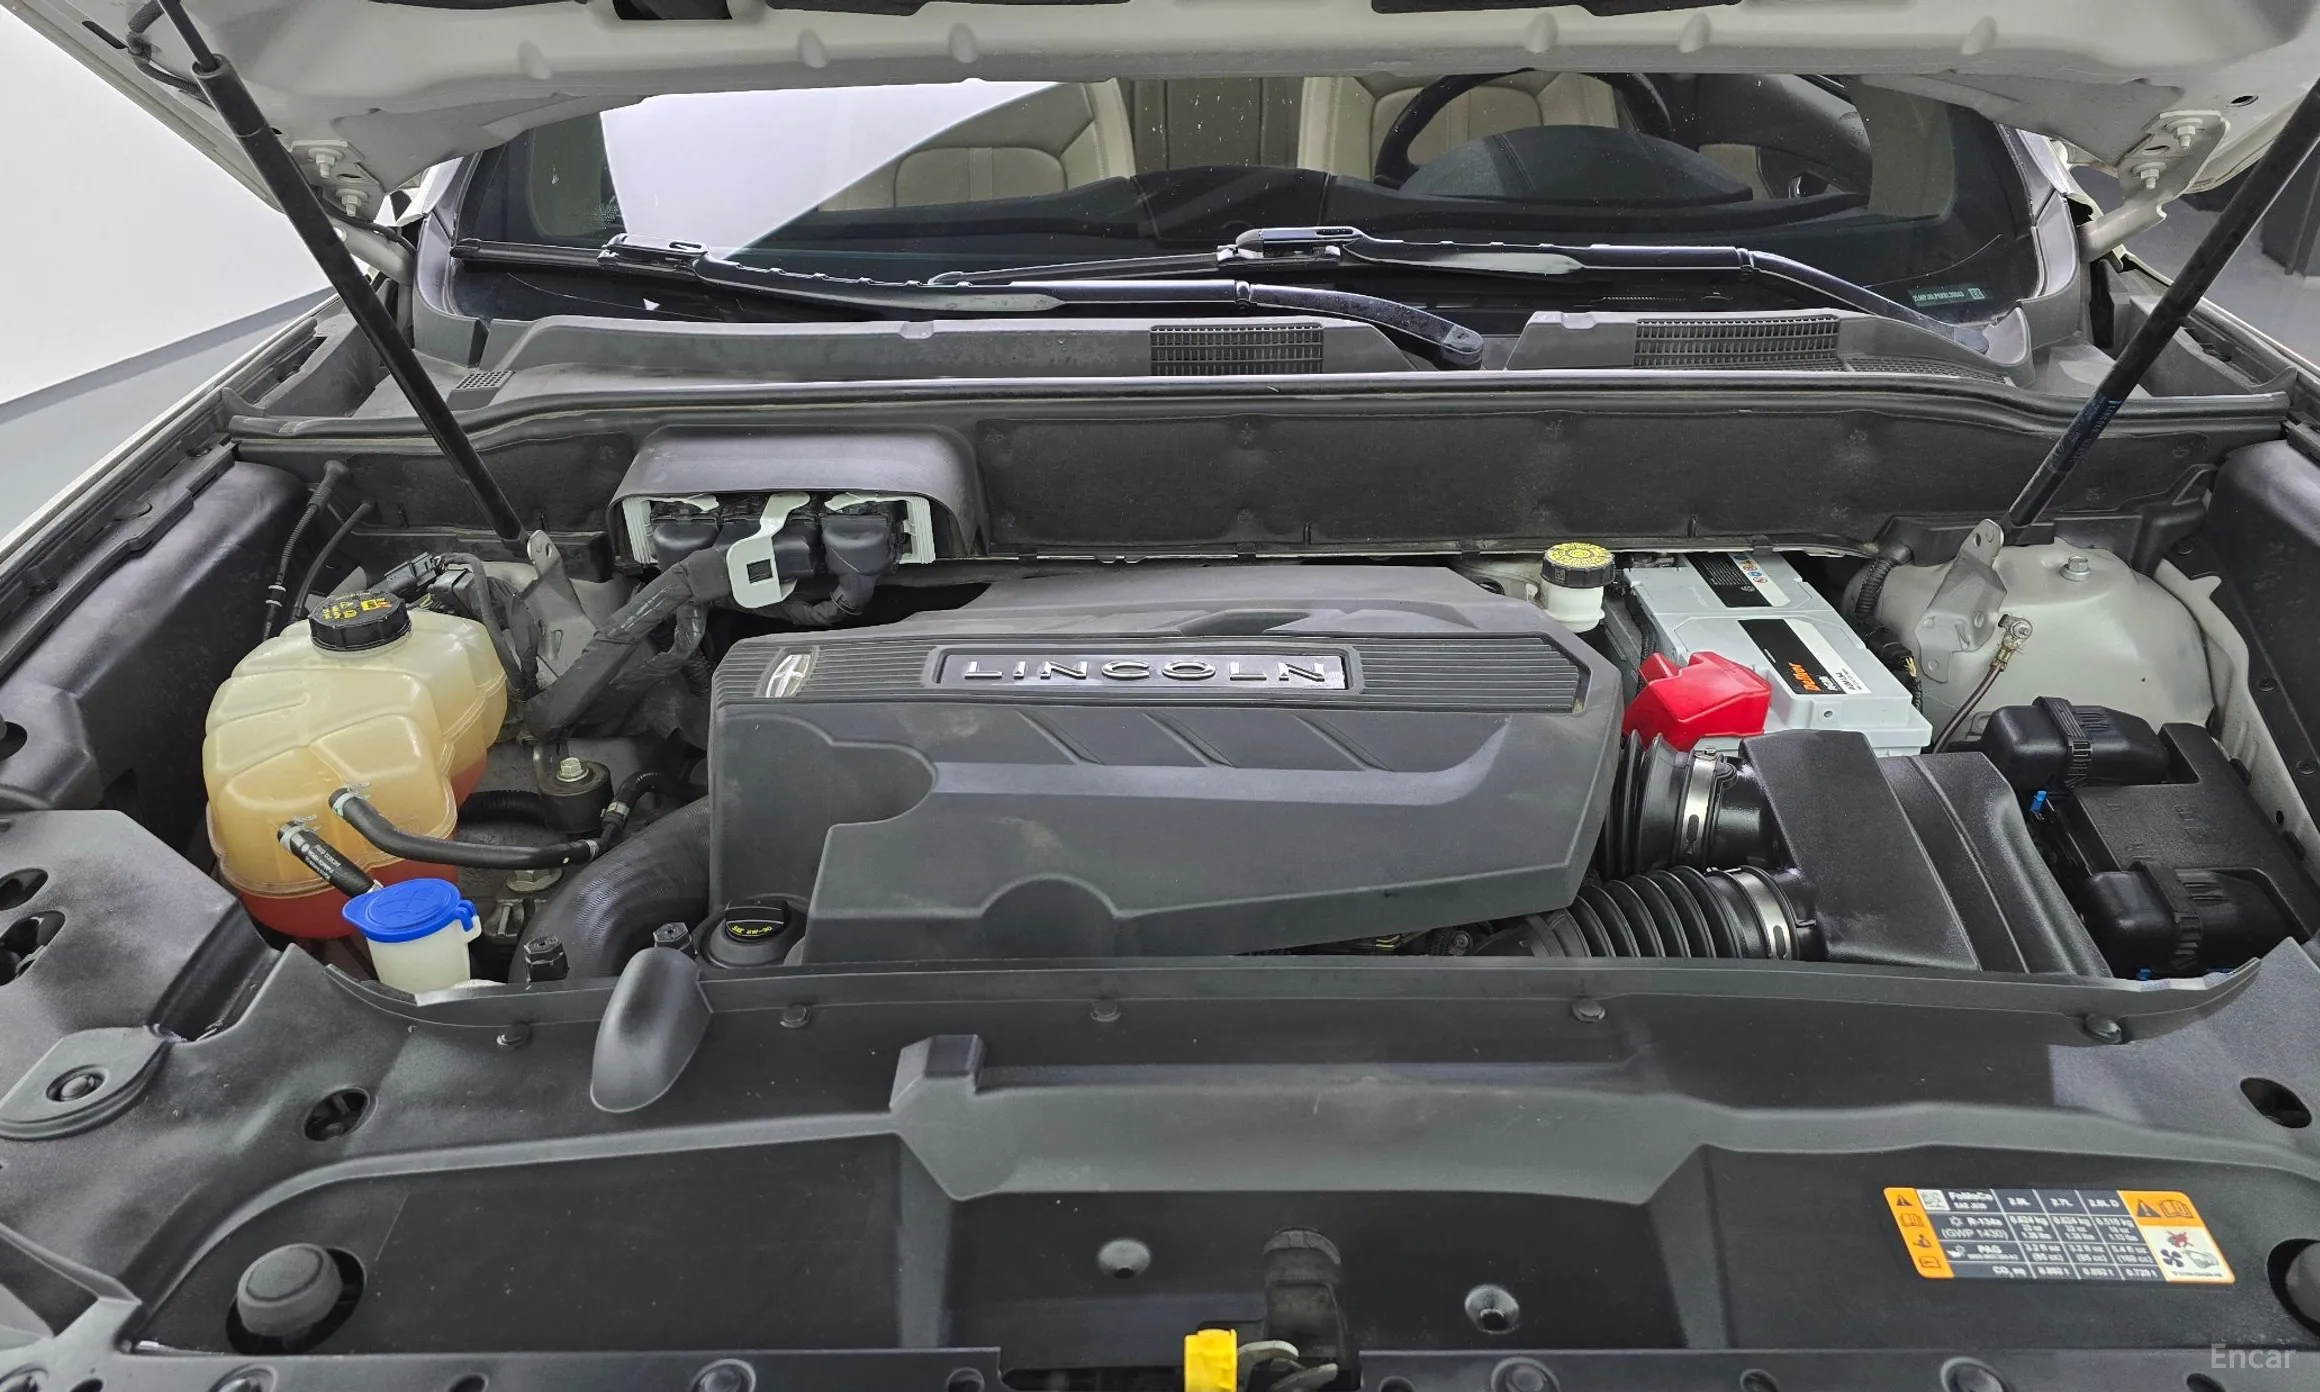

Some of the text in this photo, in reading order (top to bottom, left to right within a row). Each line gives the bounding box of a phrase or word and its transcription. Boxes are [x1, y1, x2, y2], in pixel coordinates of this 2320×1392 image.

[964, 660, 1326, 683] LINCOLN
[1948, 1191, 1994, 1202] FoMoCo
[1966, 1216, 2003, 1227] R-134a
[1941, 1228, 2009, 1241] (GWP 1430)
[1977, 1244, 2003, 1254] PAG
